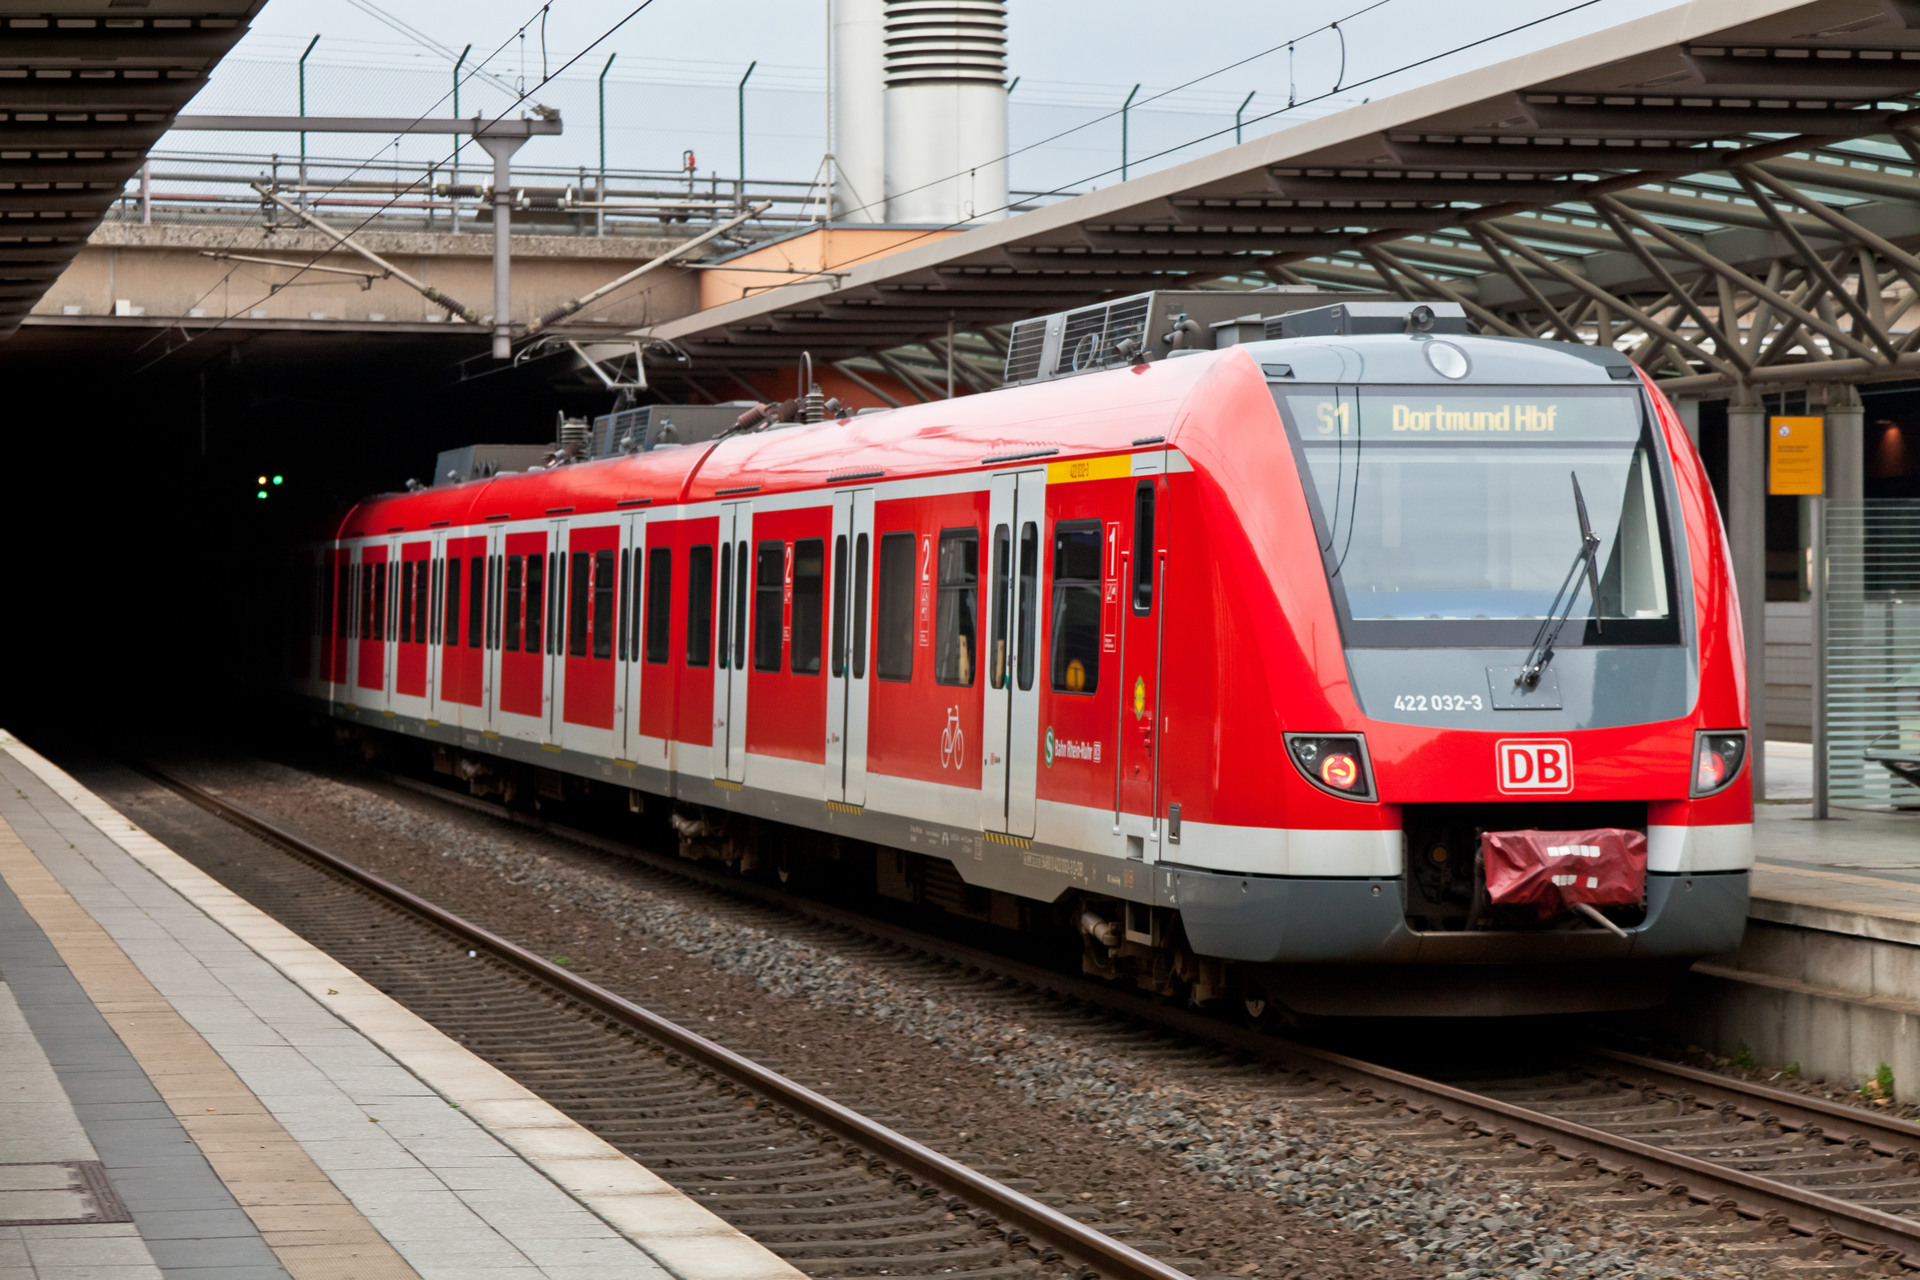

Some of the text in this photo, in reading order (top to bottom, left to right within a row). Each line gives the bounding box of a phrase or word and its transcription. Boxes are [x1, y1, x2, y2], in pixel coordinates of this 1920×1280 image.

[1316, 402, 1558, 434] S1 Dortmund Hbf
[785, 546, 792, 583] 2
[922, 539, 930, 581] 2
[1109, 527, 1116, 576] 1
[1393, 694, 1483, 711] 422 032-3
[1046, 731, 1054, 763] S
[1506, 748, 1563, 784] DB
